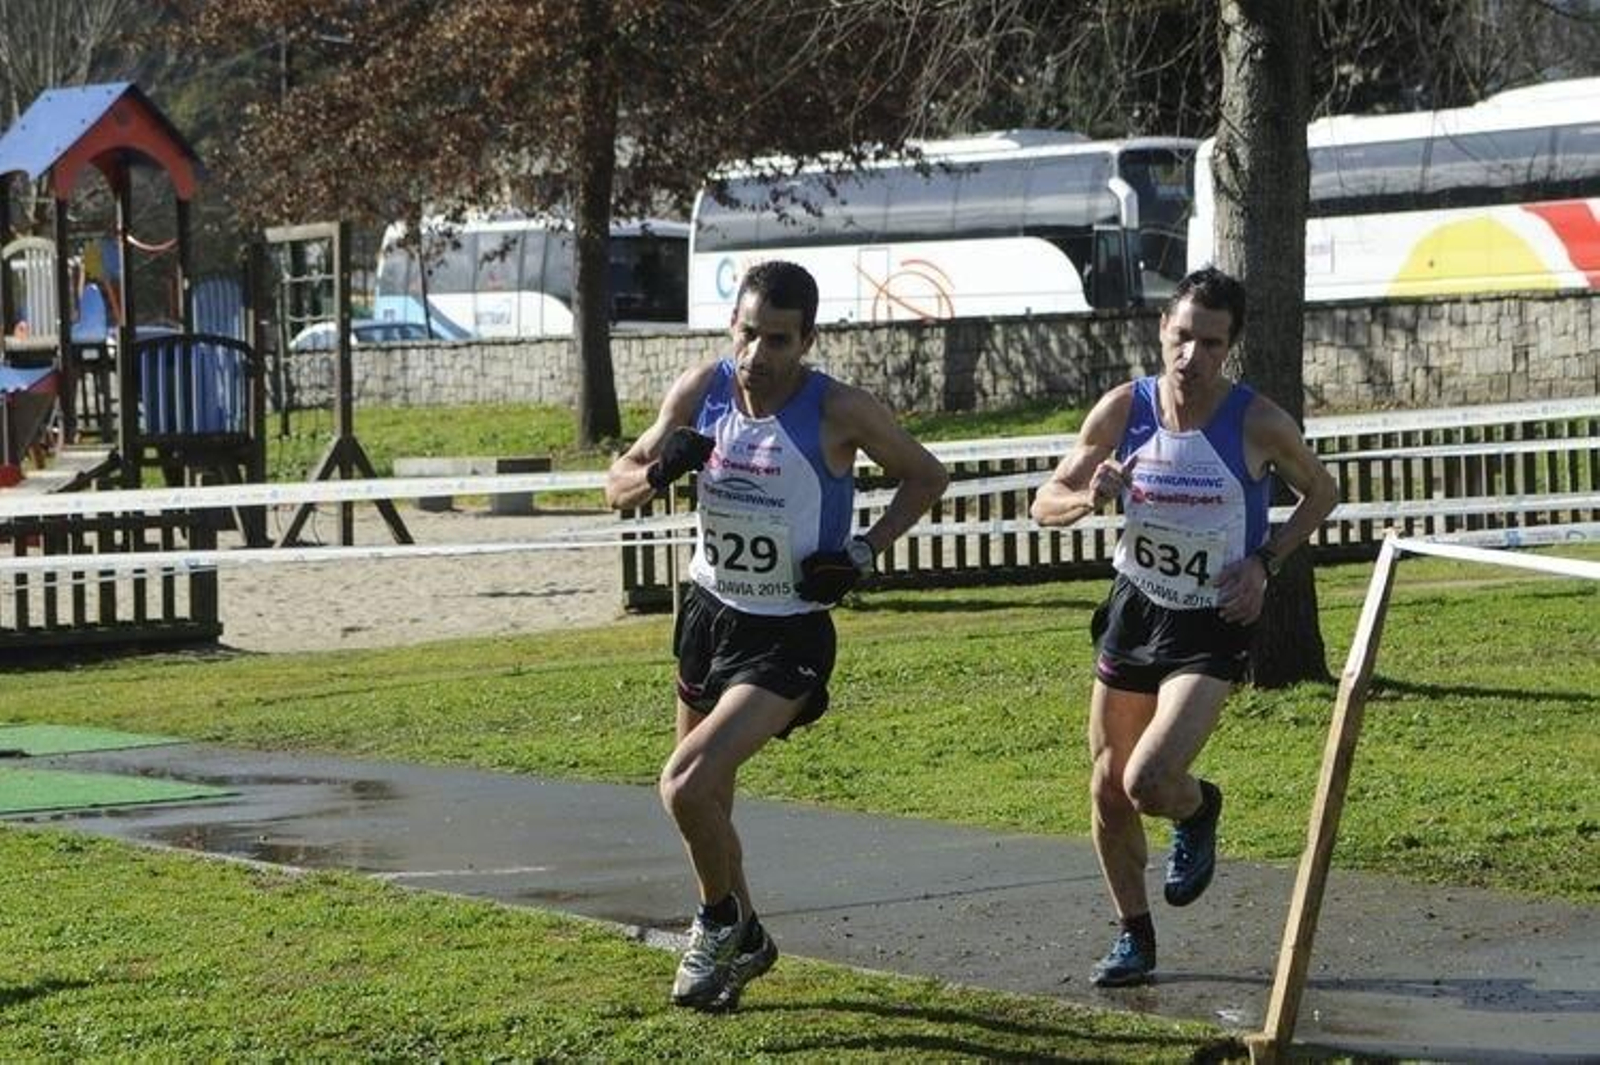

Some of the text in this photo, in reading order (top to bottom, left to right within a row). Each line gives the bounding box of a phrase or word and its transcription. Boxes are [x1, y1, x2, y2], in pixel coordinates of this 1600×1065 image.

[703, 527, 778, 574] 629
[1134, 535, 1210, 587] 634
[758, 581, 791, 596] 2015
